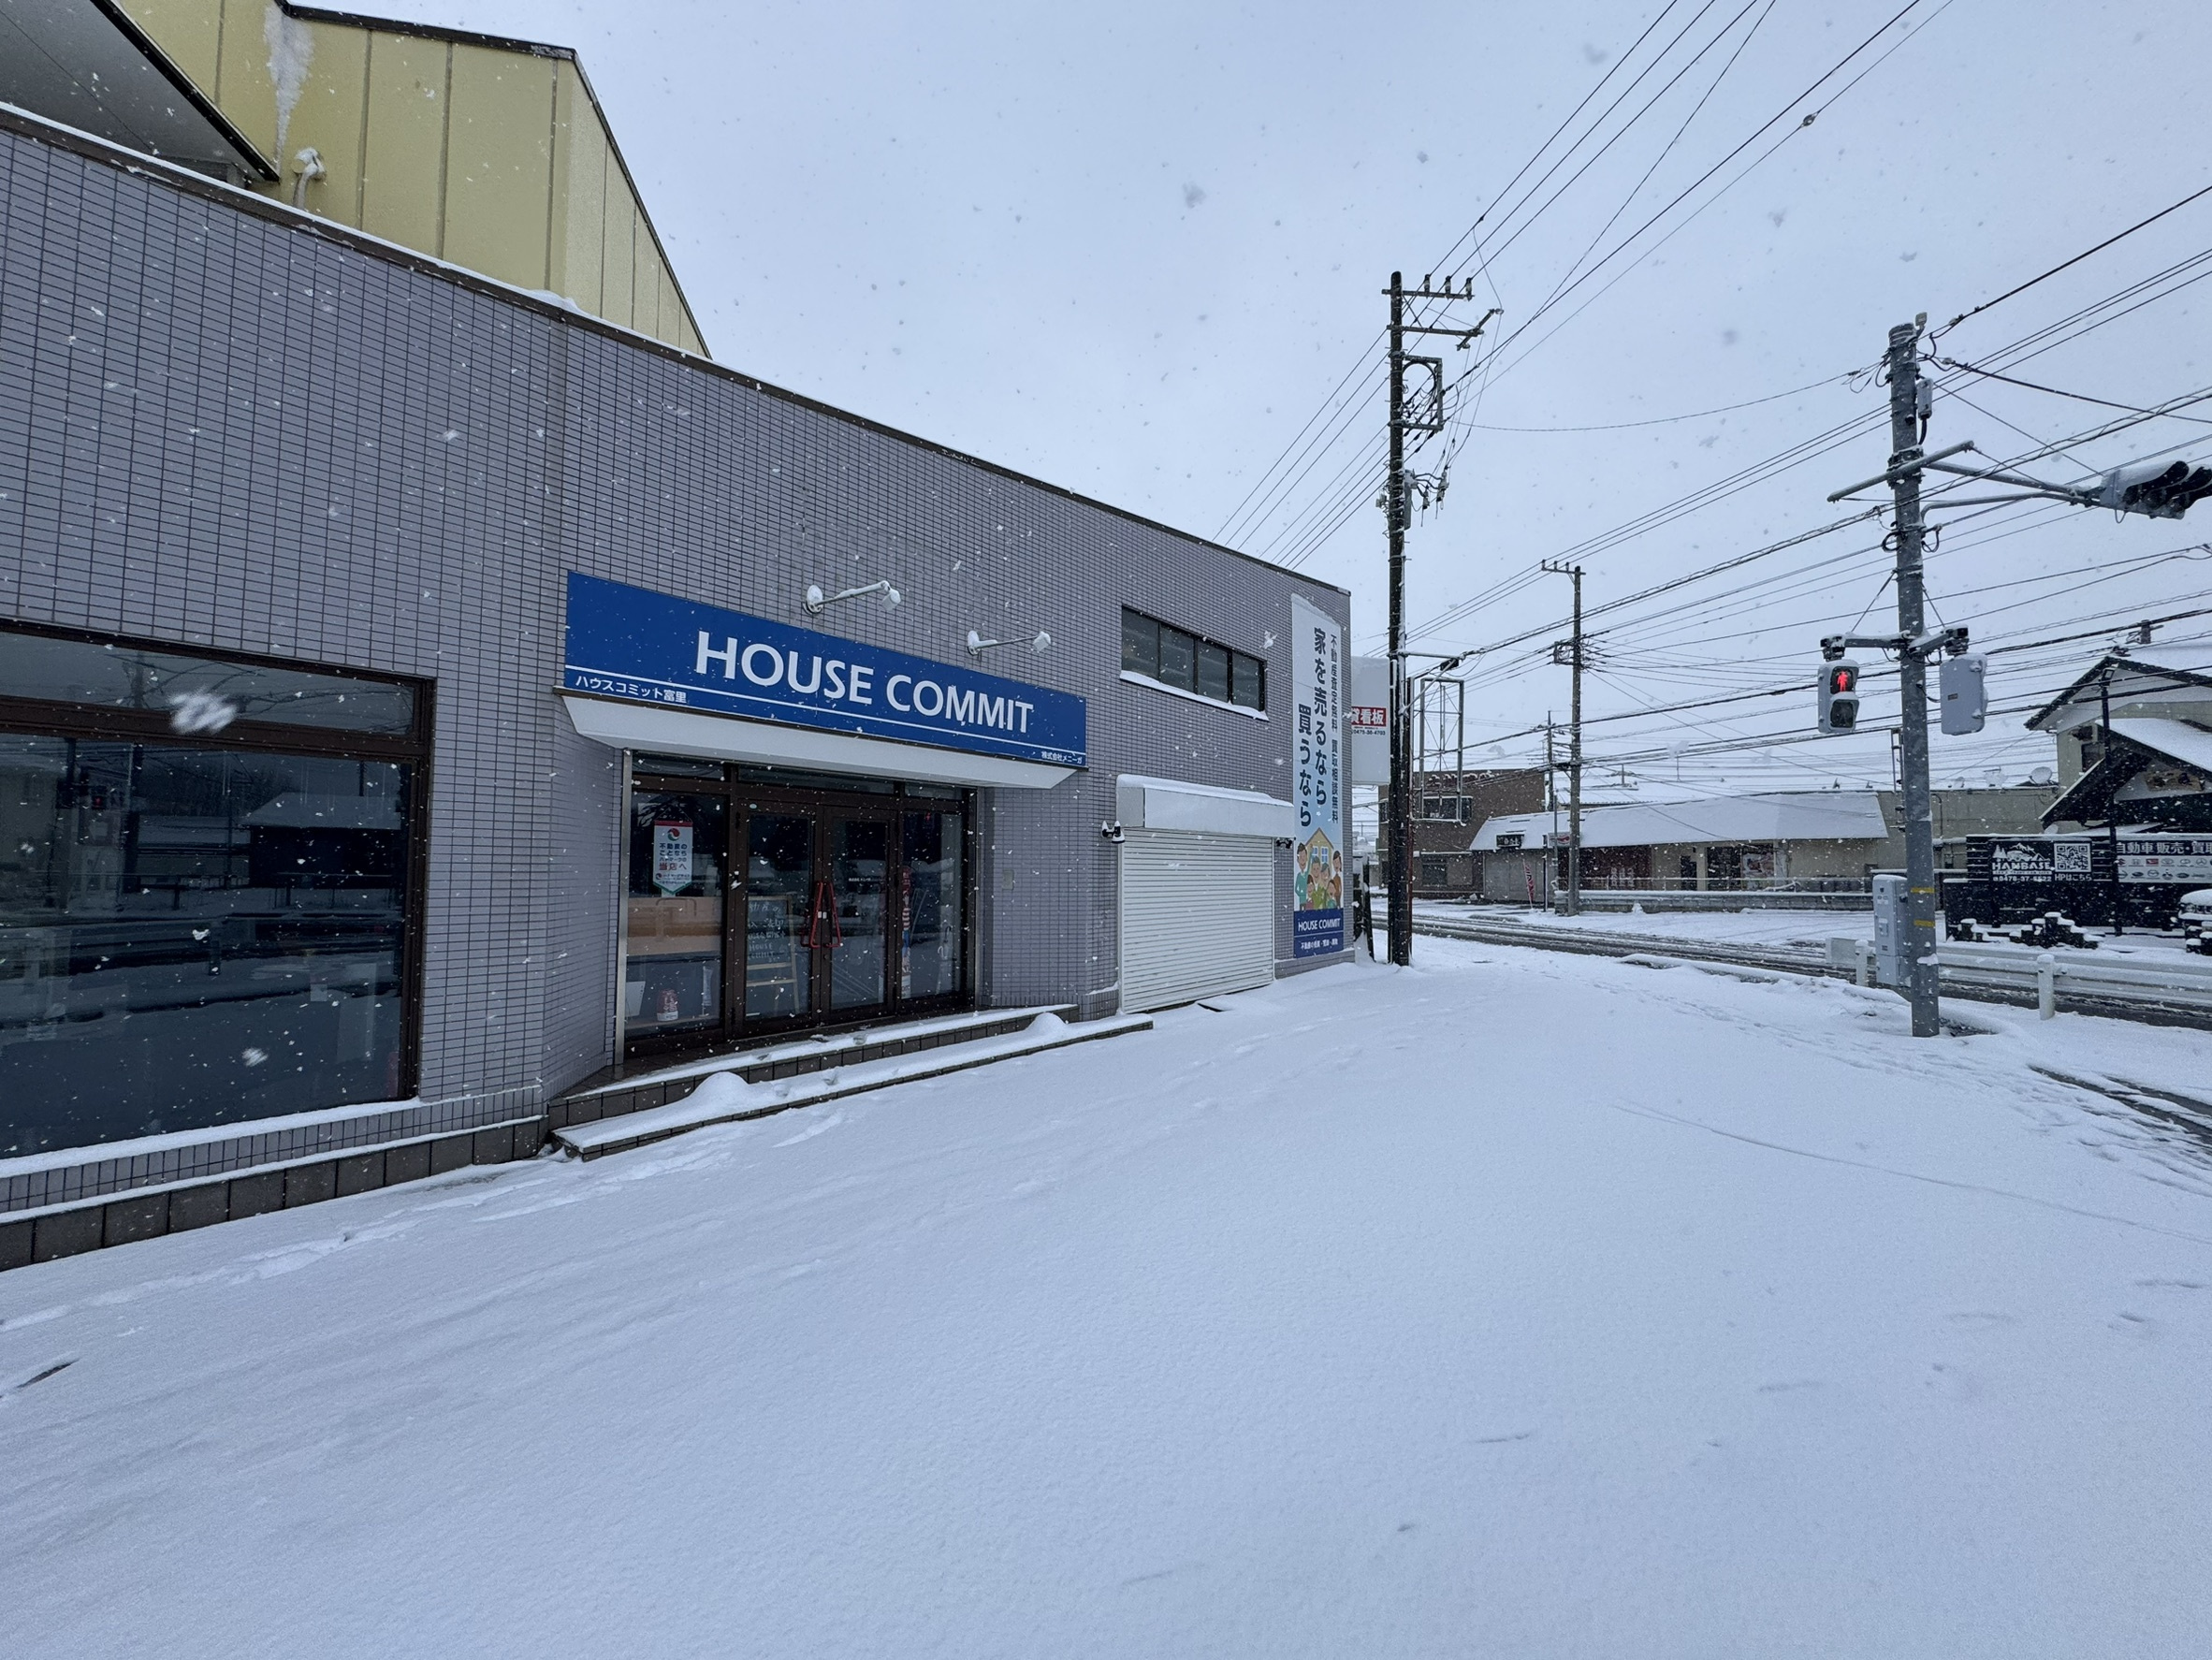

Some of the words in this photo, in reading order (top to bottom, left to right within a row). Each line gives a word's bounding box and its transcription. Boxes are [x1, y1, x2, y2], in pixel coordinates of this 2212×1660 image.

[575, 676, 687, 704] ハウスコミット富里
[695, 631, 874, 705] HOUSE
[886, 675, 1034, 733] COMMIT
[1313, 627, 1327, 805] 家を売るなら
[1299, 704, 1312, 827] 買うなら
[1298, 920, 1318, 932] HOUSE
